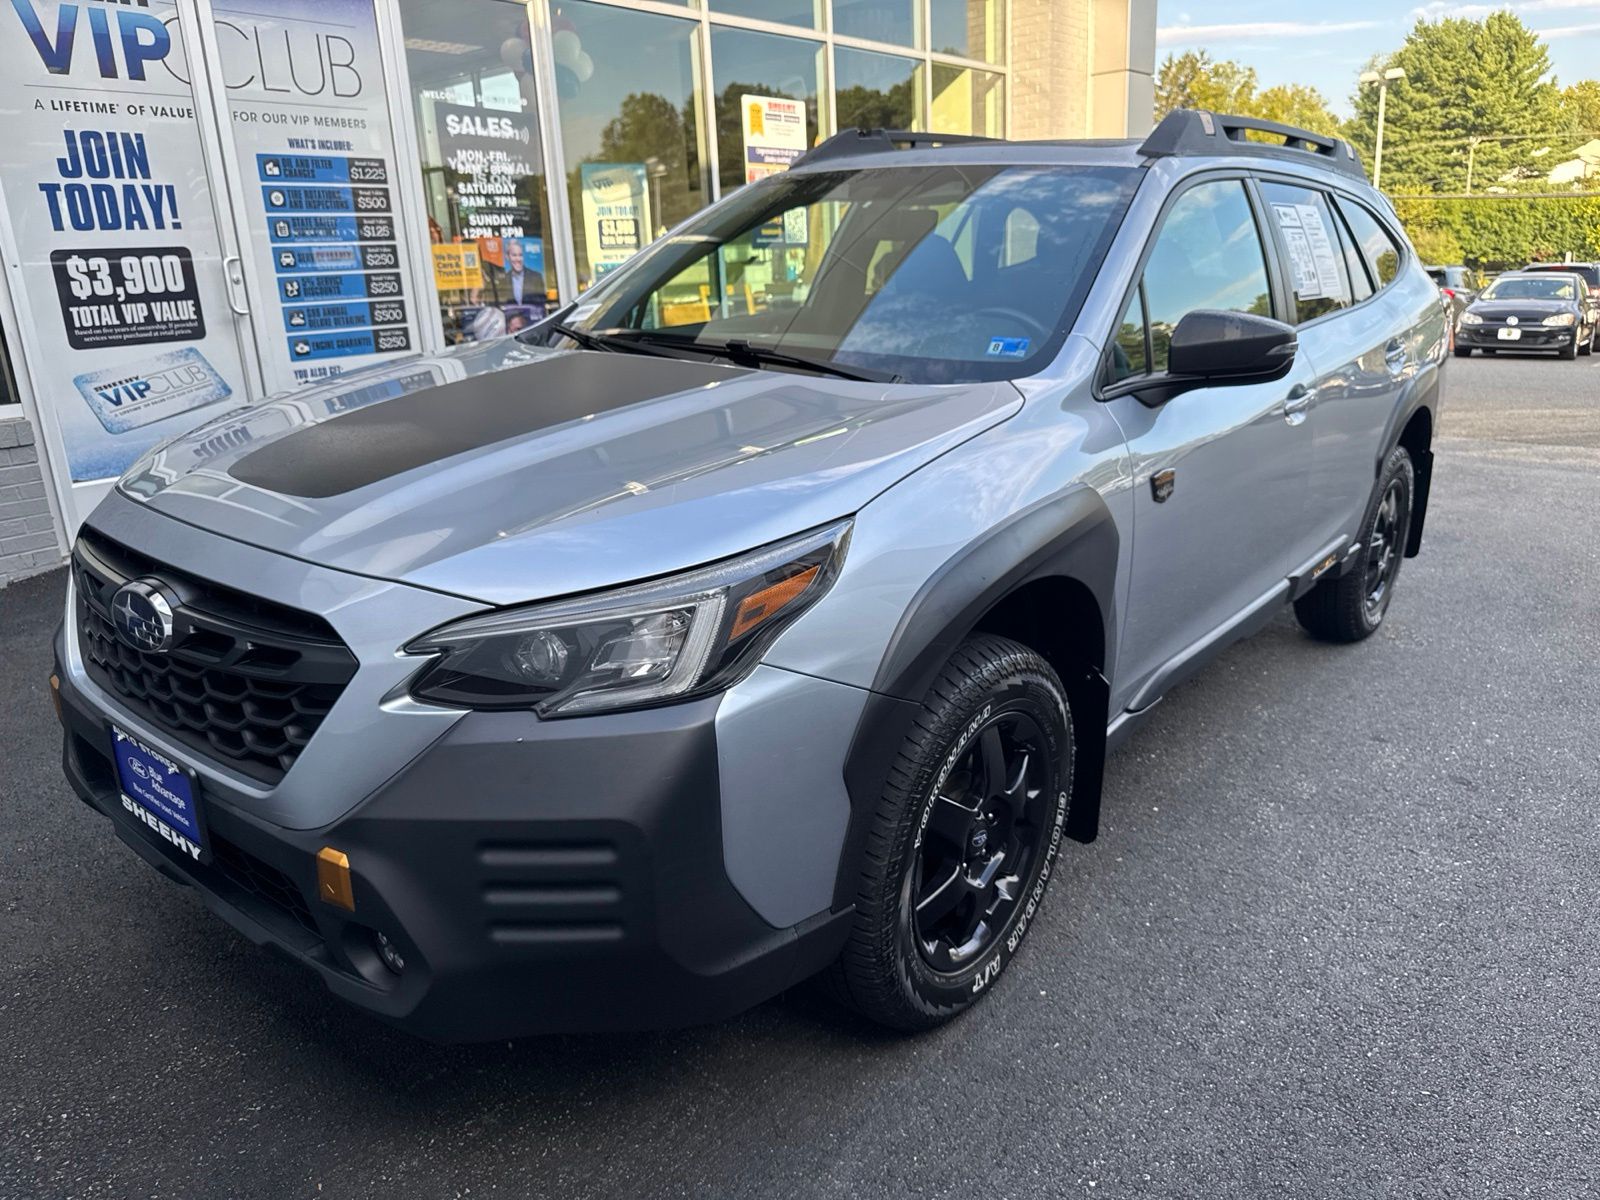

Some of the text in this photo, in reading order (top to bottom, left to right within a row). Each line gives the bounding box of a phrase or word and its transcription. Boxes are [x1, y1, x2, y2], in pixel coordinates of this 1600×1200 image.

[10, 0, 171, 82] VIP
[34, 98, 45, 111] A
[127, 104, 146, 117] OF
[151, 106, 194, 119] VALUE
[232, 111, 368, 130] FOR OUR VIP MEMBERS
[287, 137, 316, 150] WHAT'S
[56, 129, 152, 180] JOIN
[458, 182, 517, 195] SATURDAY
[38, 182, 183, 232] TODAY!
[357, 197, 387, 209] $500
[460, 196, 486, 208] 9AM
[495, 196, 518, 208] 7PM
[468, 214, 515, 227] SUNDAY
[363, 225, 390, 238] $125
[462, 227, 493, 240] 12PM
[500, 227, 524, 239] 5PM
[366, 253, 395, 267] $250
[65, 254, 186, 302] $3,900
[370, 281, 399, 295] $250
[69, 300, 198, 328] TOTAL VIP VALUE
[374, 309, 403, 322] $500
[74, 328, 93, 336] Based
[378, 336, 407, 350] $250
[992, 343, 1000, 352] 8
[293, 368, 308, 381] YOU
[310, 366, 329, 378] ALSO
[98, 379, 151, 407] VIP
[147, 364, 208, 395] CLUB
[120, 793, 201, 861] SHEEHY
[972, 953, 1001, 993] A/T
